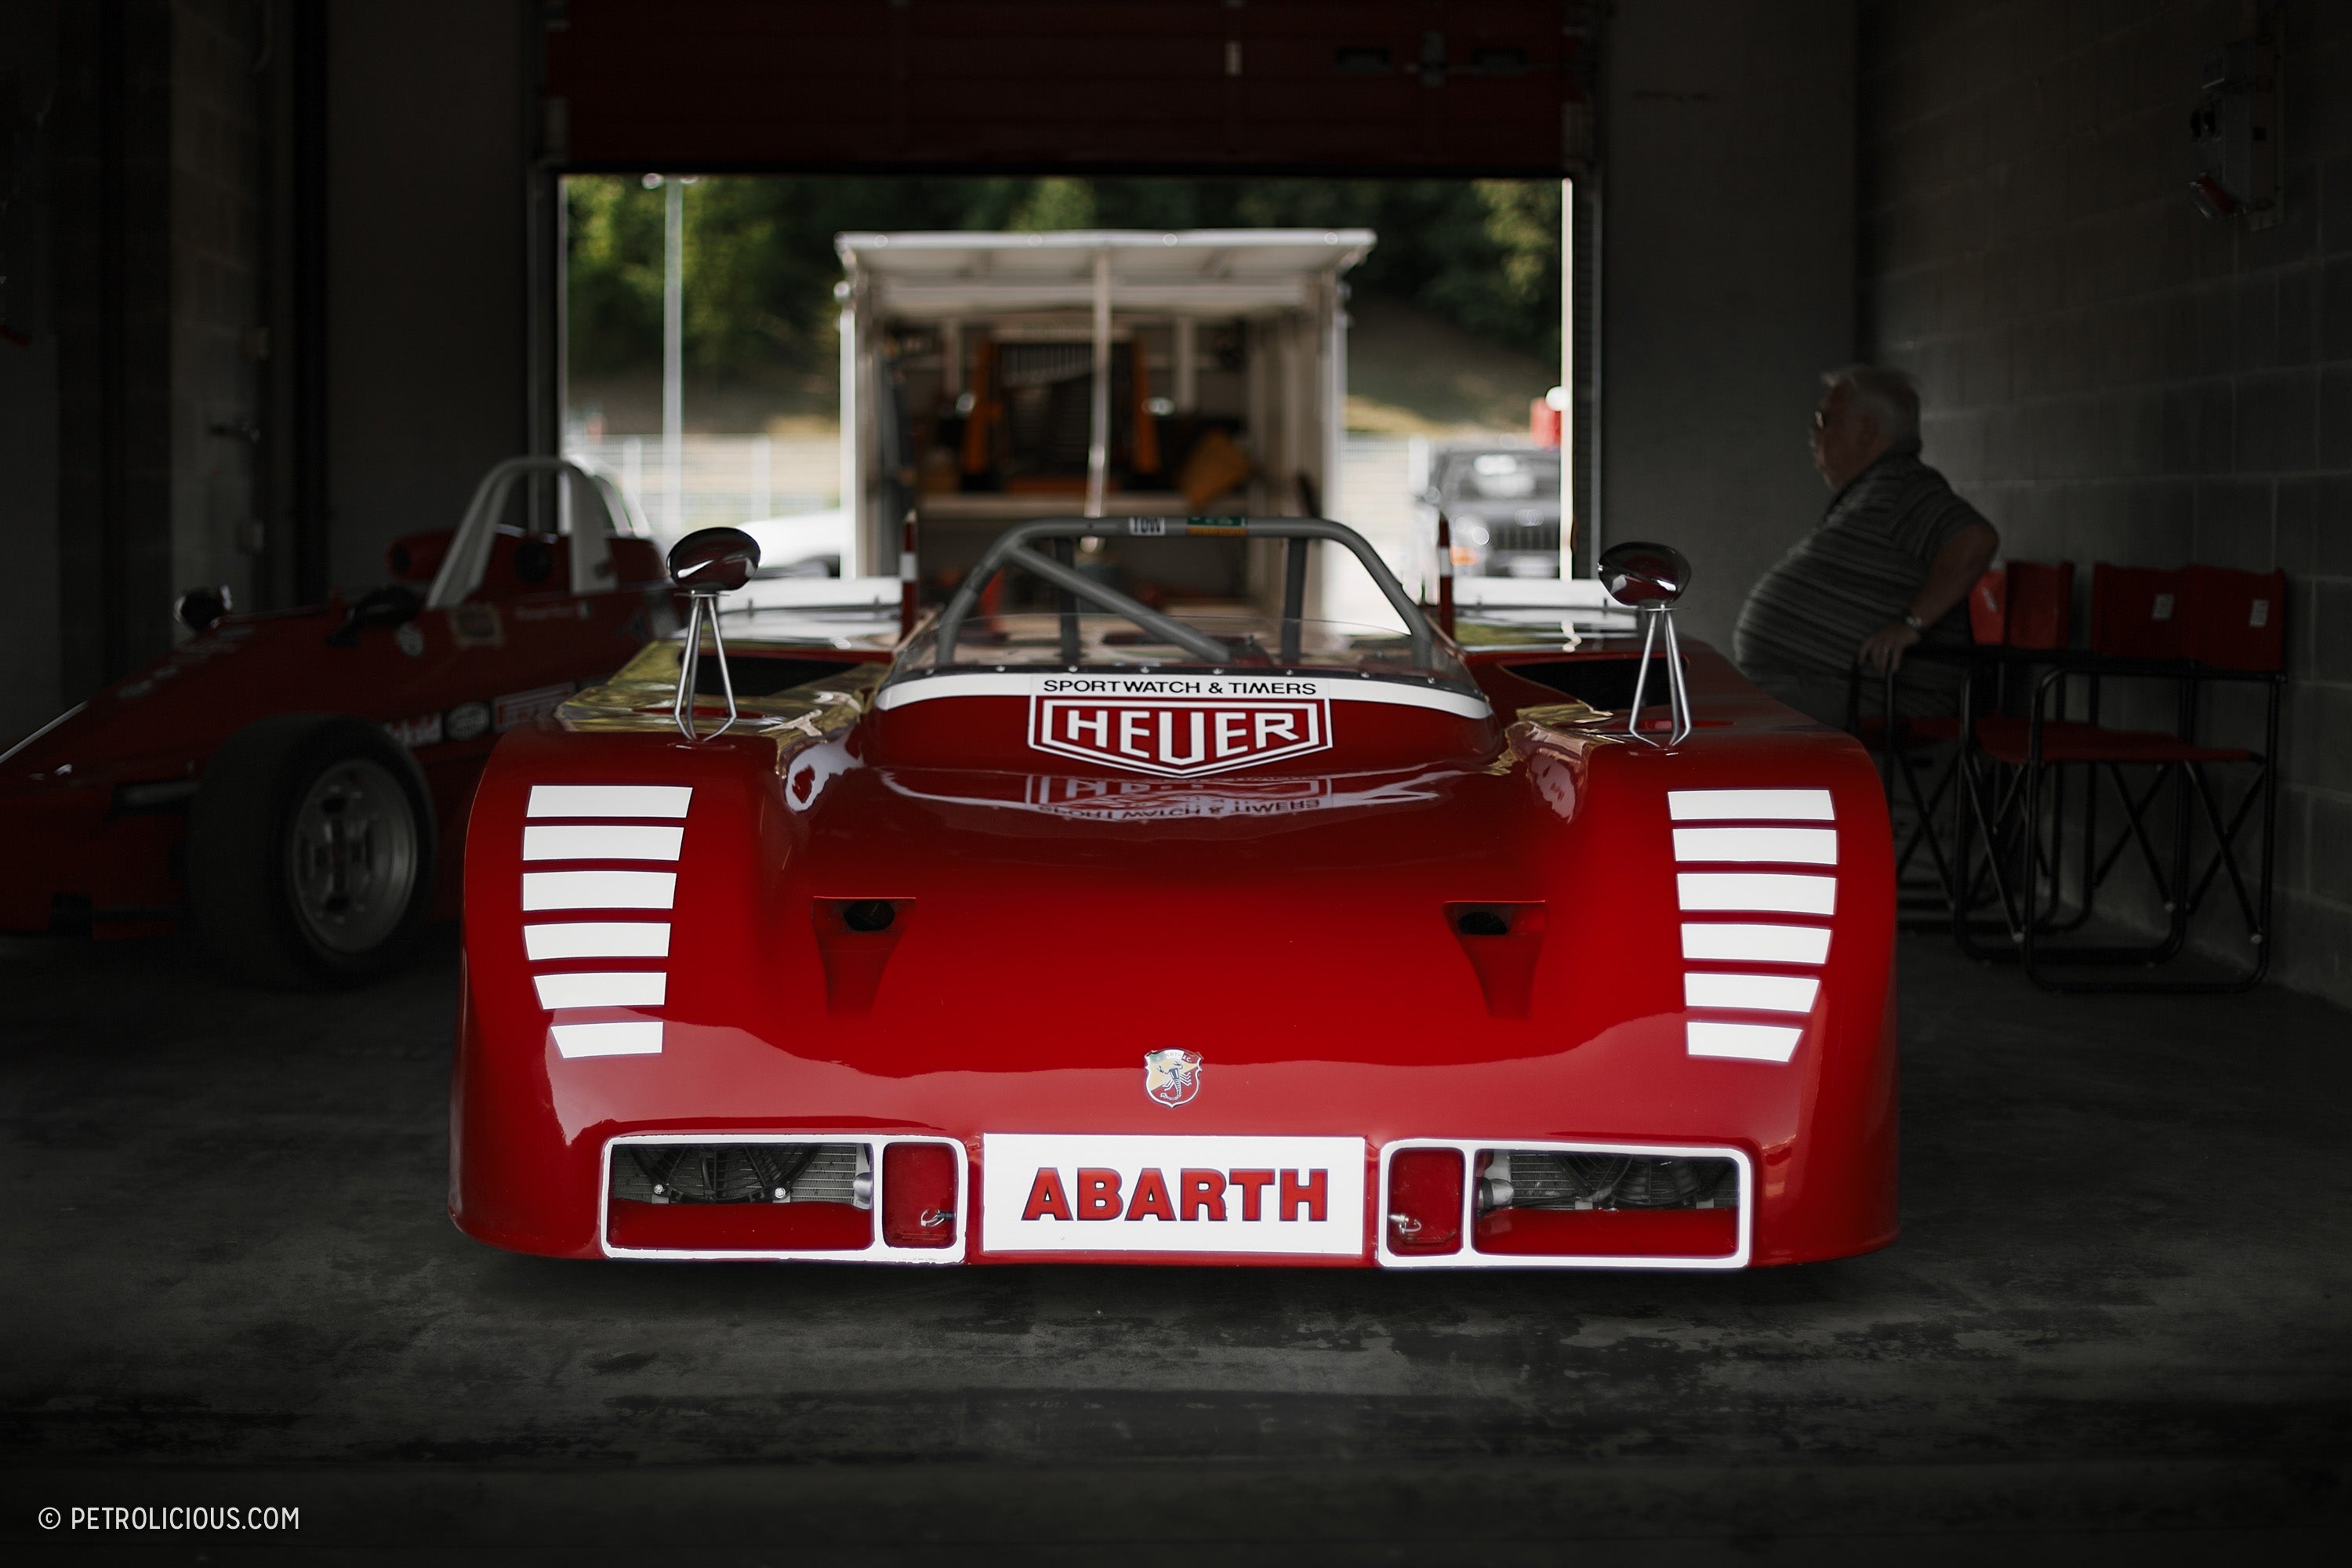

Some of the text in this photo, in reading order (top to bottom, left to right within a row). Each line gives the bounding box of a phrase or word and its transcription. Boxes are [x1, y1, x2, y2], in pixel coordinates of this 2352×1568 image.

[1132, 517, 1162, 533] TOW
[1208, 682, 1223, 694] &
[1228, 682, 1316, 695] TIMERS
[1067, 710, 1300, 766] HEUER
[1021, 1167, 1328, 1222] ABARTH
